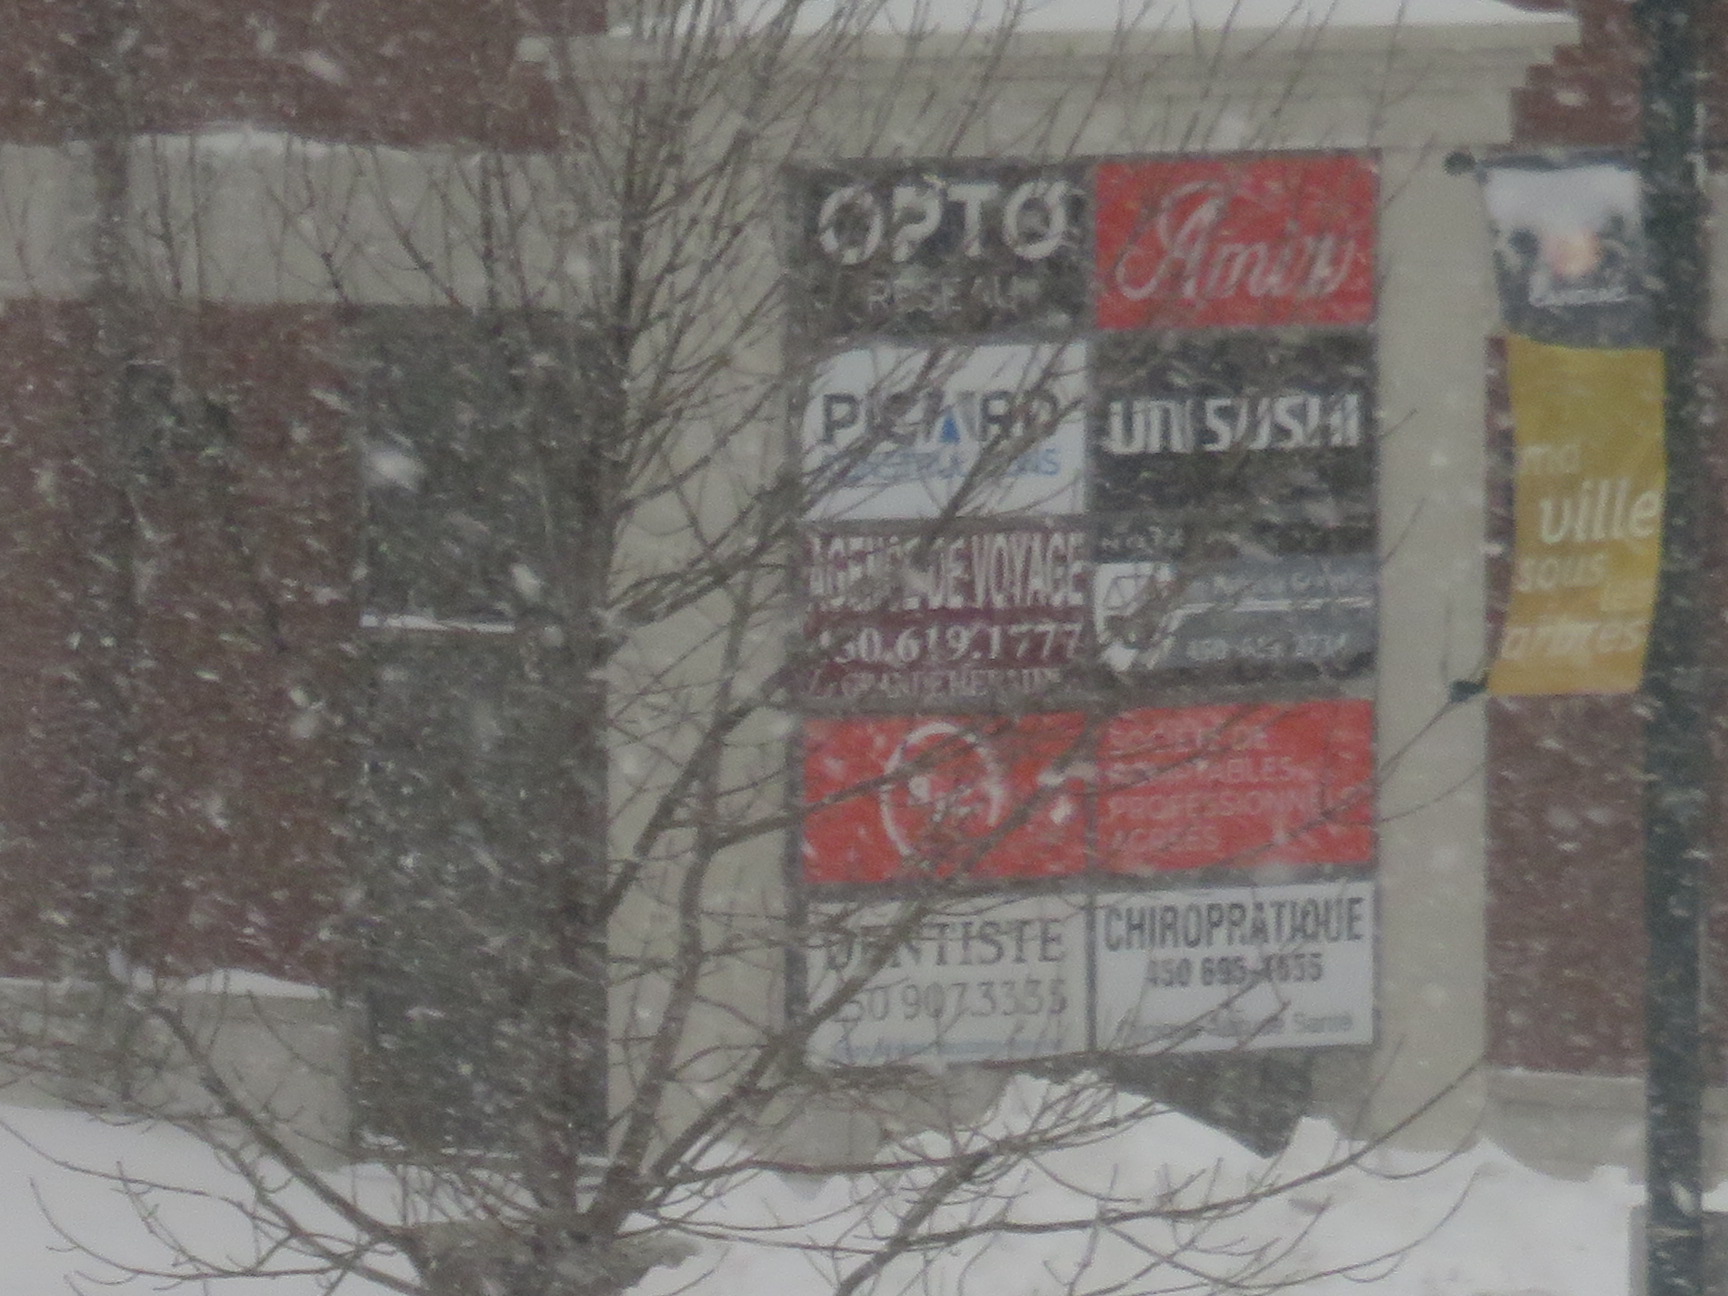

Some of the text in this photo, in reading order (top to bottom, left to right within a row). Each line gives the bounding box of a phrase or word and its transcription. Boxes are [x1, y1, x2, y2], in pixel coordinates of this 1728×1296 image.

[818, 180, 1068, 265] OPTO
[1204, 393, 1359, 452] SUSHI
[1540, 478, 1663, 545] ville
[928, 536, 966, 608] DE
[972, 531, 1086, 608] VOYAGE
[1104, 896, 1364, 952] CHIROPRATIQUE
